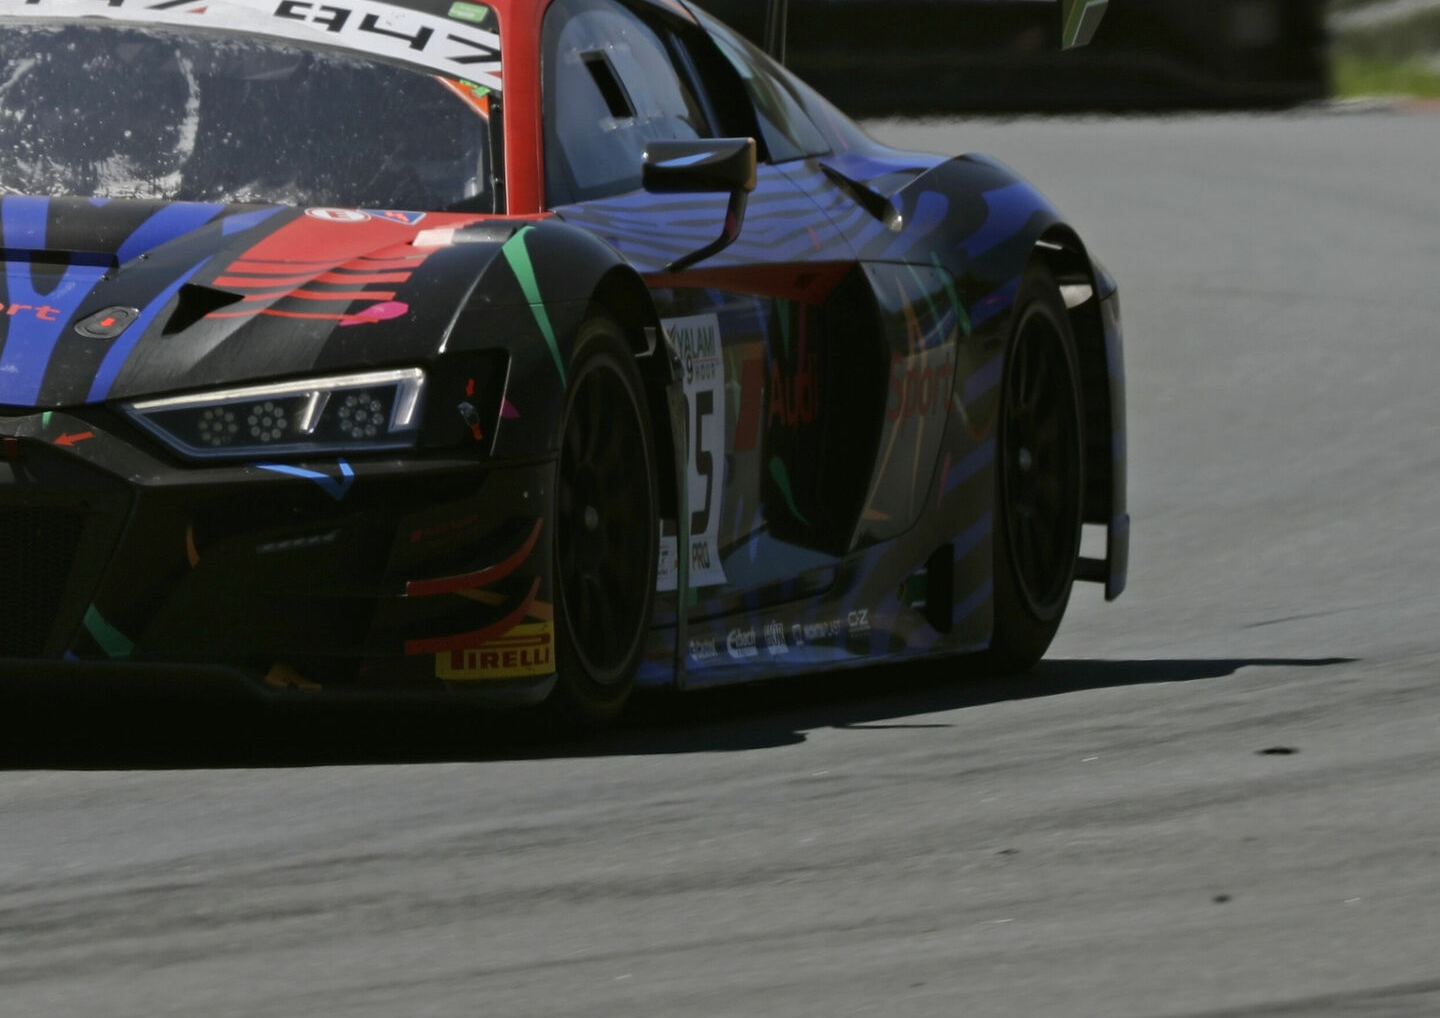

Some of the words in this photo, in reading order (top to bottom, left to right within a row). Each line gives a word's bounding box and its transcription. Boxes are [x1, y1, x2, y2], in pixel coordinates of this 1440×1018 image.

[768, 354, 818, 429] Audi
[887, 350, 956, 428] Sport
[692, 541, 711, 571] PRO
[450, 632, 551, 671] PIRELLI
